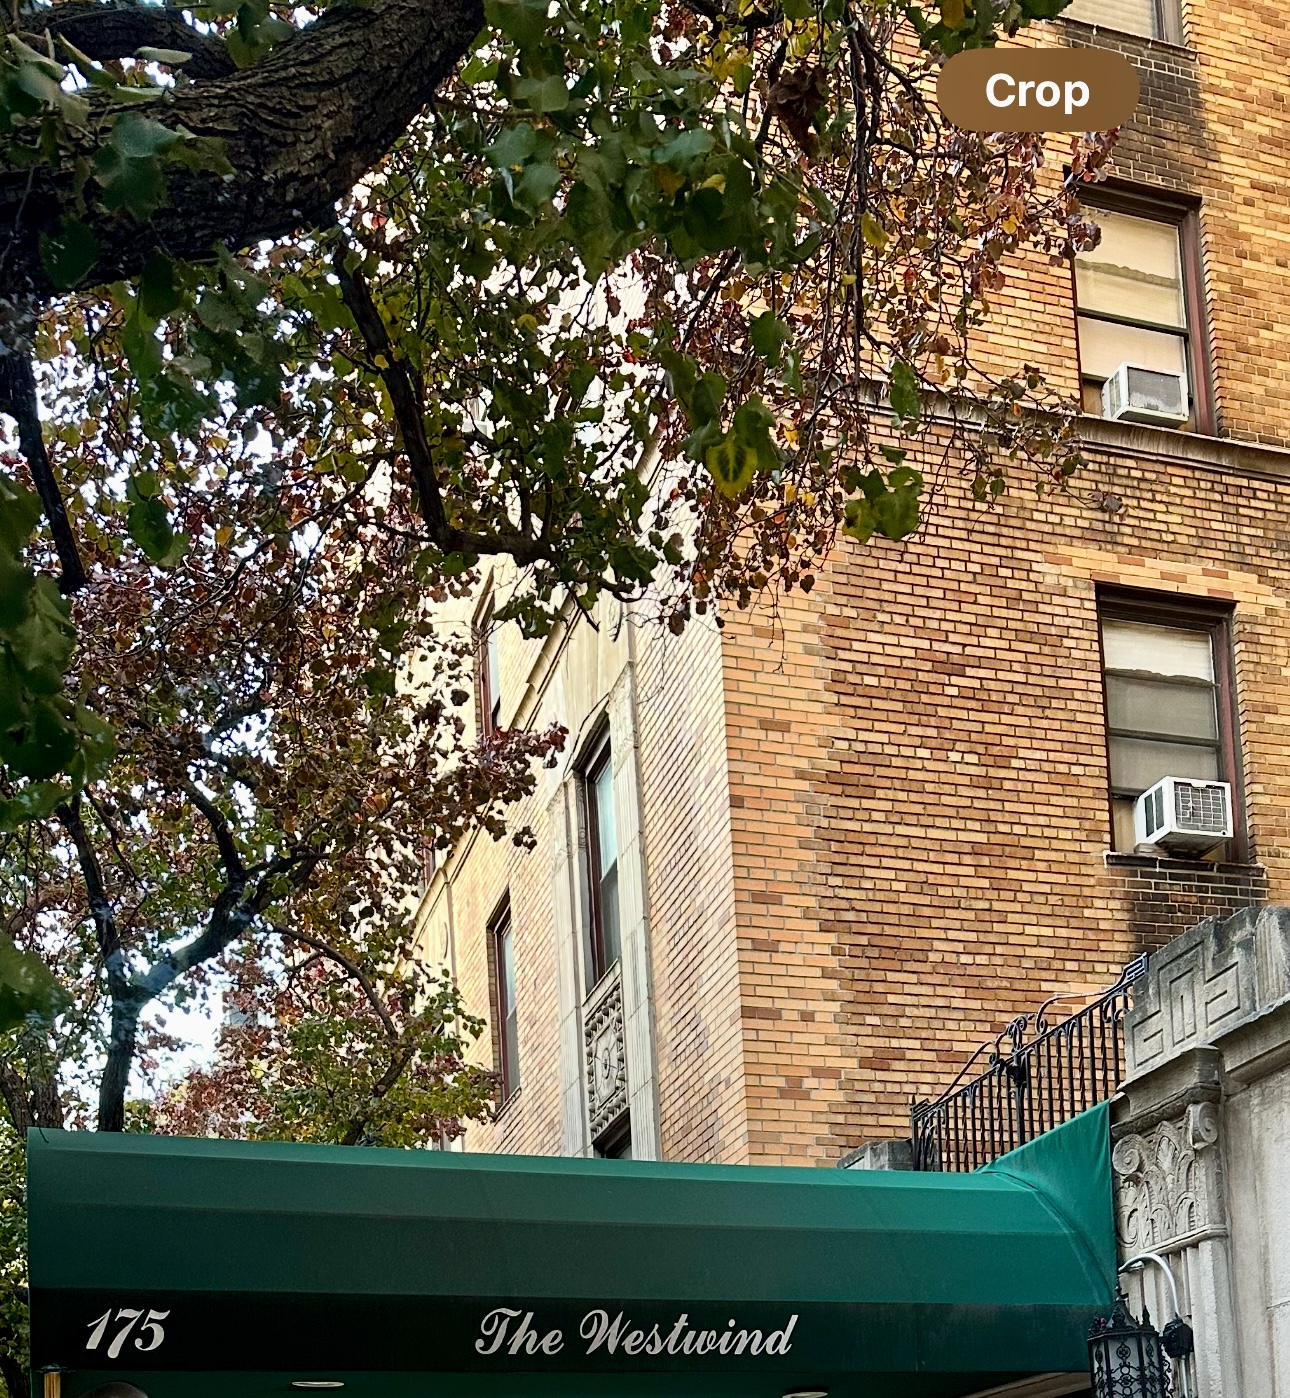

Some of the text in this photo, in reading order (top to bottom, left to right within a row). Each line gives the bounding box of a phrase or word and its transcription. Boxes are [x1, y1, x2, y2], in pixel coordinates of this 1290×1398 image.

[86, 1308, 171, 1359] 175
[475, 1308, 799, 1356] The Westwind
